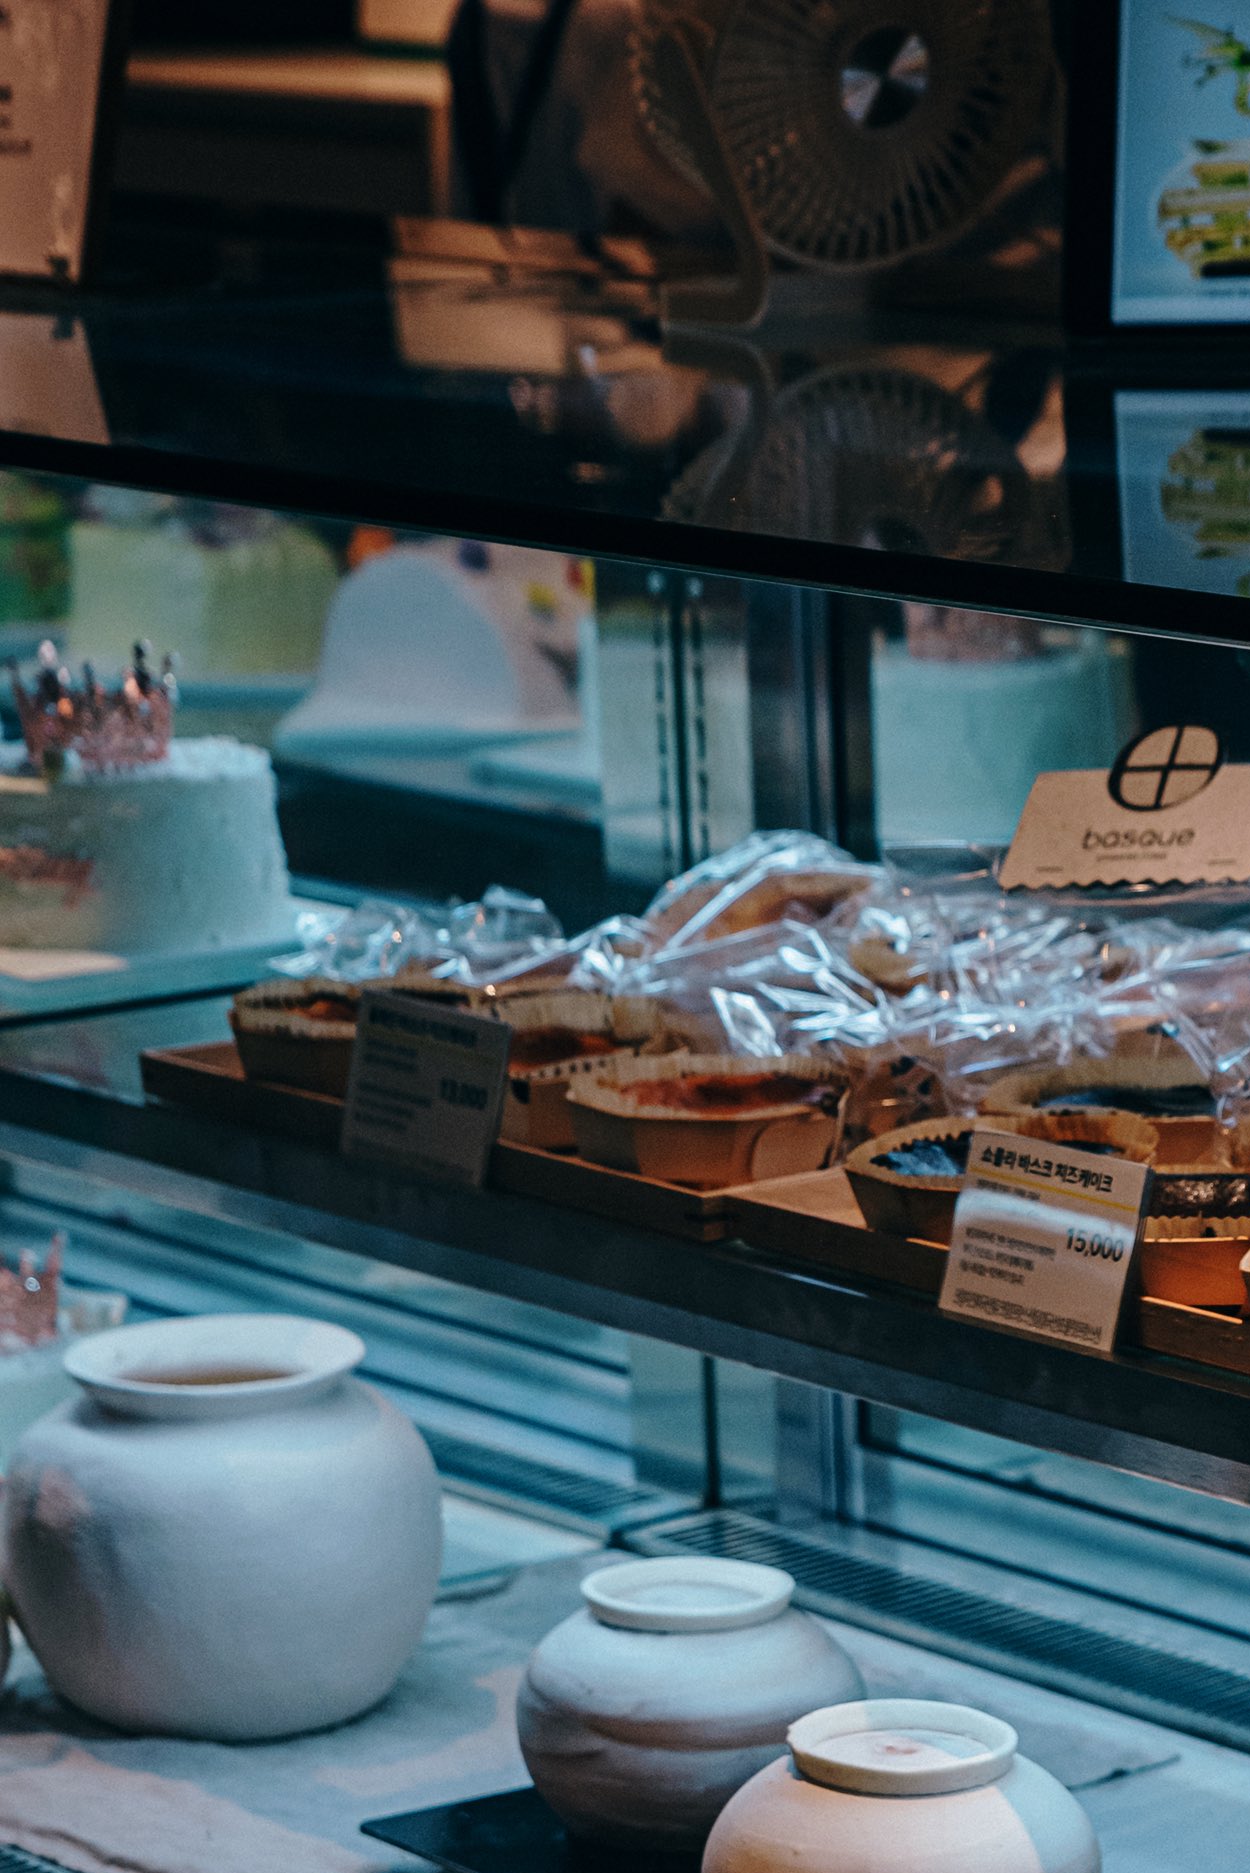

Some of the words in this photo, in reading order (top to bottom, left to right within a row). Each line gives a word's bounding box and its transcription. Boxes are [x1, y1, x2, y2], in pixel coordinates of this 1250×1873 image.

[1082, 827, 1196, 851] basque
[1018, 1155, 1053, 1177] 바스크
[1055, 1163, 1113, 1192] 치즈케이크
[1066, 1228, 1124, 1262] 15,000
